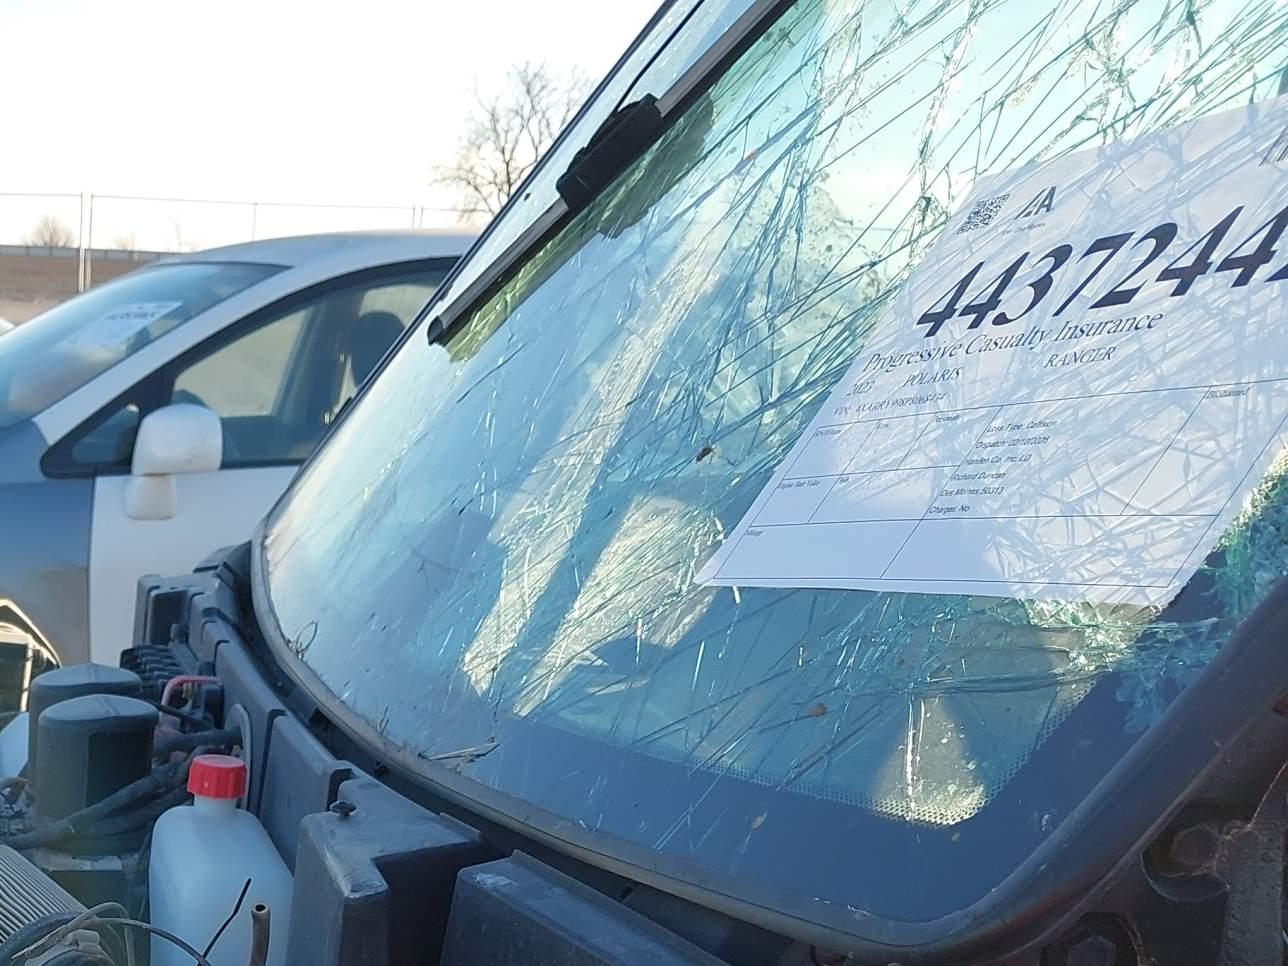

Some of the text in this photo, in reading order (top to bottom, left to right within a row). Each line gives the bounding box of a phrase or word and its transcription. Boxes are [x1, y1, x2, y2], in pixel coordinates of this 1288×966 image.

[916, 205, 1288, 338] 4437244
[863, 313, 1164, 374] Progressive Casualty Insurance
[846, 346, 1117, 396] 2023 POLARIS RANGER
[987, 424, 1003, 432] Loss
[940, 488, 953, 497] Des
[959, 504, 970, 512] No
